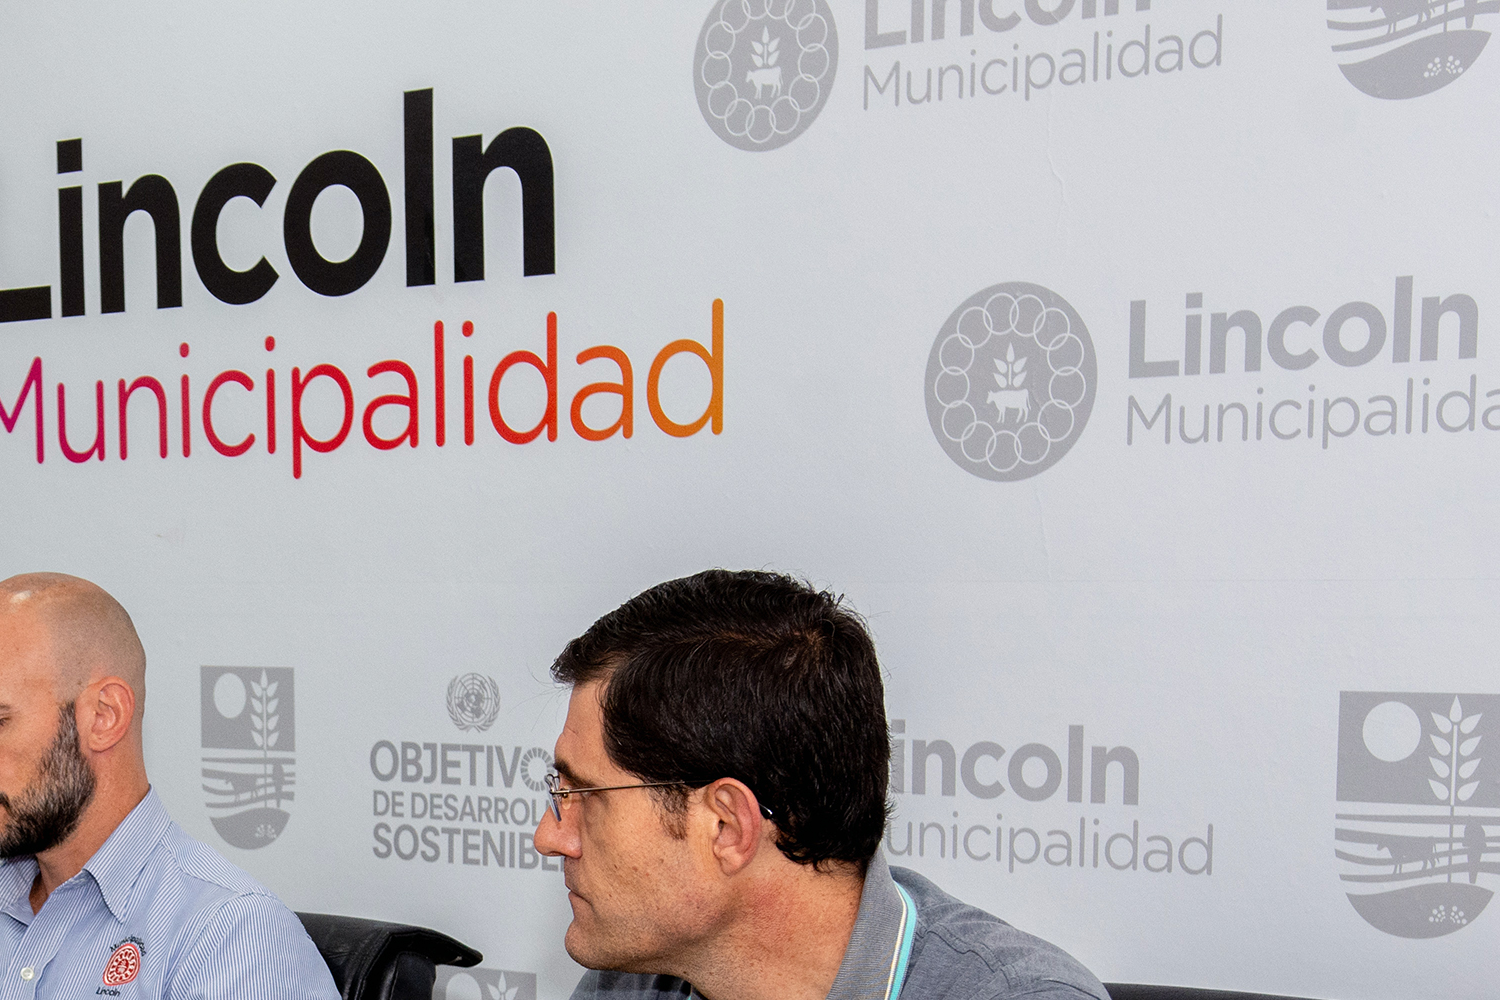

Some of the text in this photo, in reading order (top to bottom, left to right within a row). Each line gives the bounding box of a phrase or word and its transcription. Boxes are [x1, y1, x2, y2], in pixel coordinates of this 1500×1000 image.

[863, 13, 1223, 111] Municipalidad
[1128, 274, 1479, 379] Lincoln
[1126, 373, 1500, 450] Municipalida
[369, 739, 557, 792] OBJETIVO
[890, 718, 1140, 806] incoln
[373, 789, 551, 827] DE DESARROL
[886, 810, 1214, 876] unicipalidad
